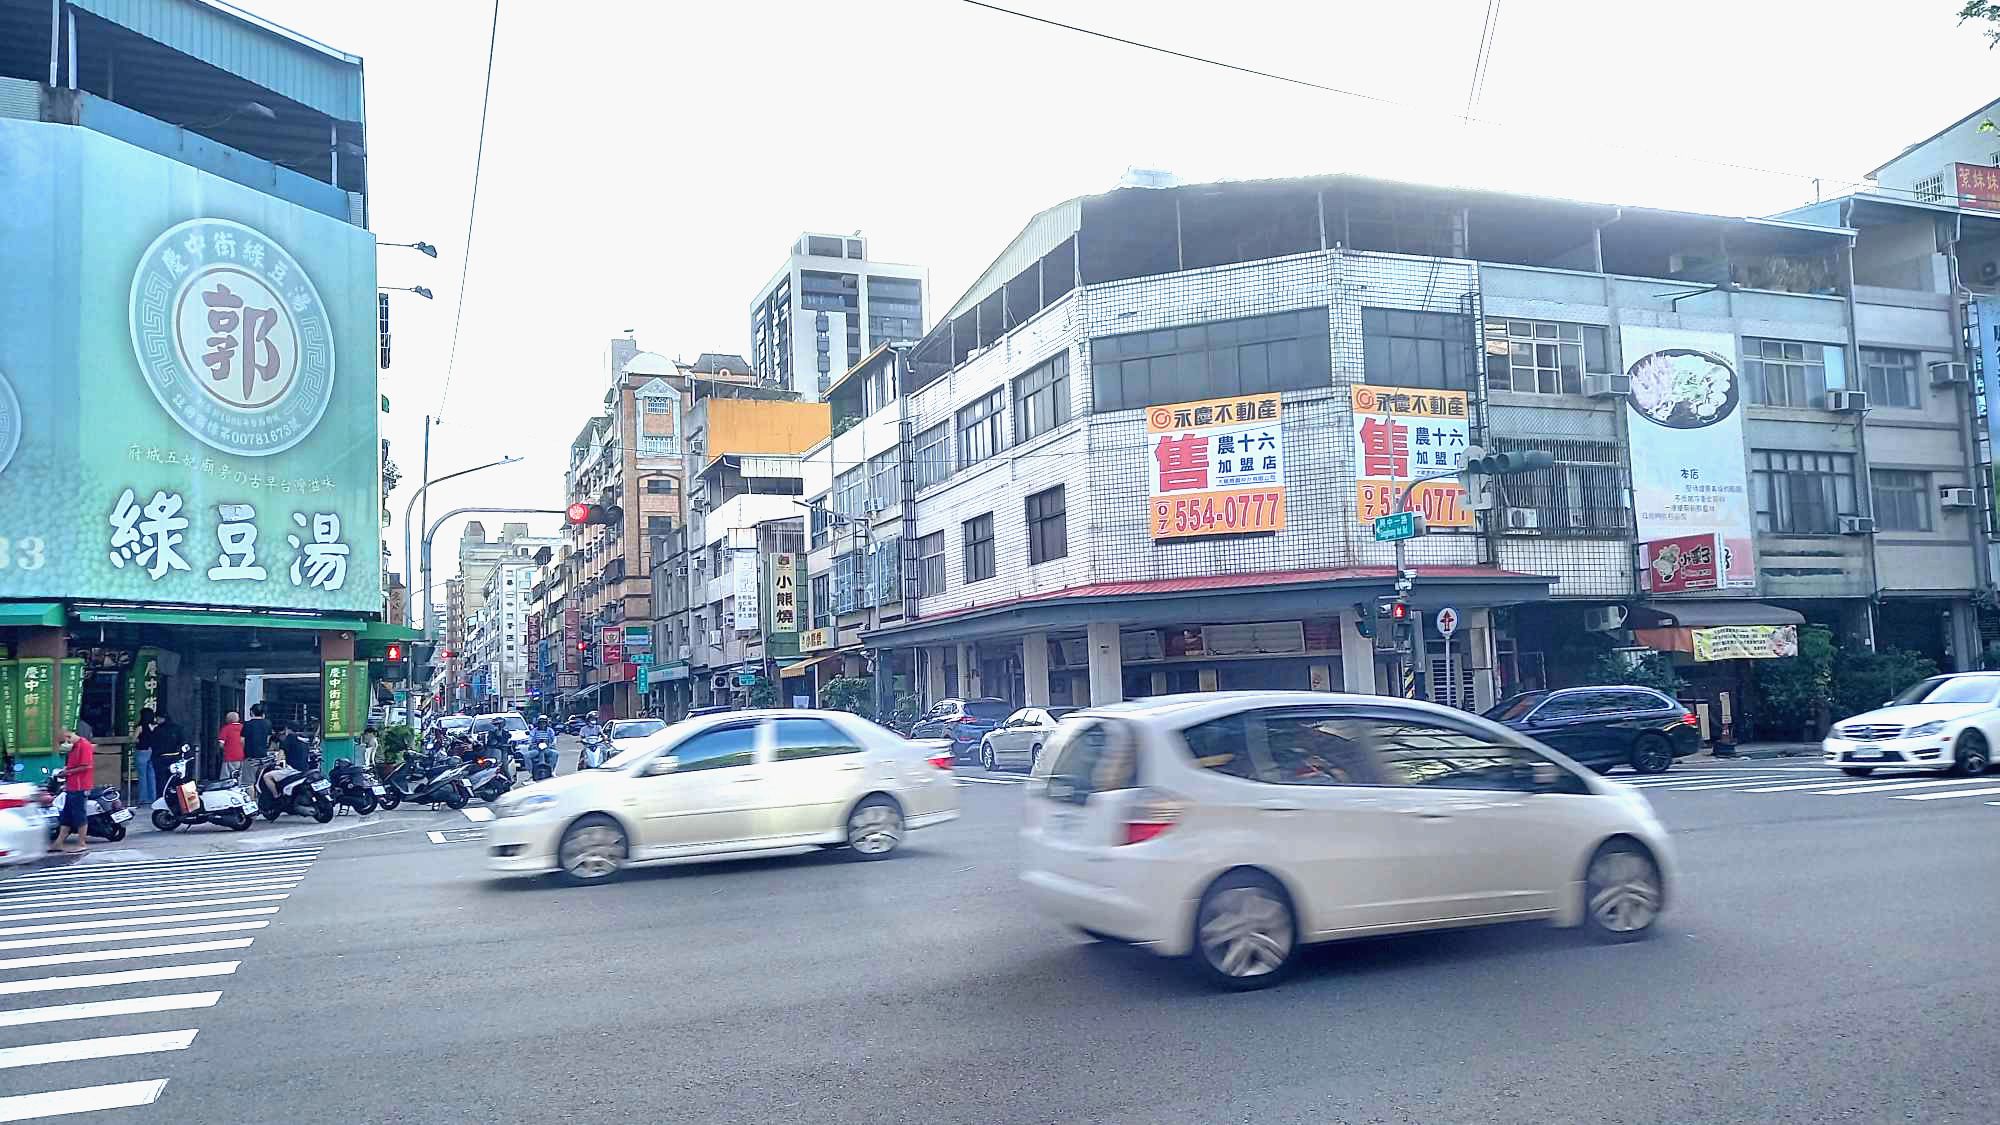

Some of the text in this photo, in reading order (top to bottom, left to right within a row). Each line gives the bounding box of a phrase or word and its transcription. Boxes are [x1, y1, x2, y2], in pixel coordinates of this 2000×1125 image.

[201, 283, 281, 401] 郭
[1174, 399, 1277, 428] 永慶不動產
[1376, 393, 1465, 416] 永慶不動產
[1217, 432, 1276, 455] 農十六
[1360, 417, 1409, 477] 售
[1415, 426, 1464, 447] 農十六
[1154, 433, 1209, 492] 售
[1217, 455, 1277, 474] 加盟店
[1175, 493, 1280, 533] 554-0777
[109, 488, 350, 591] 綠豆湯
[776, 574, 794, 624] 小熊燒
